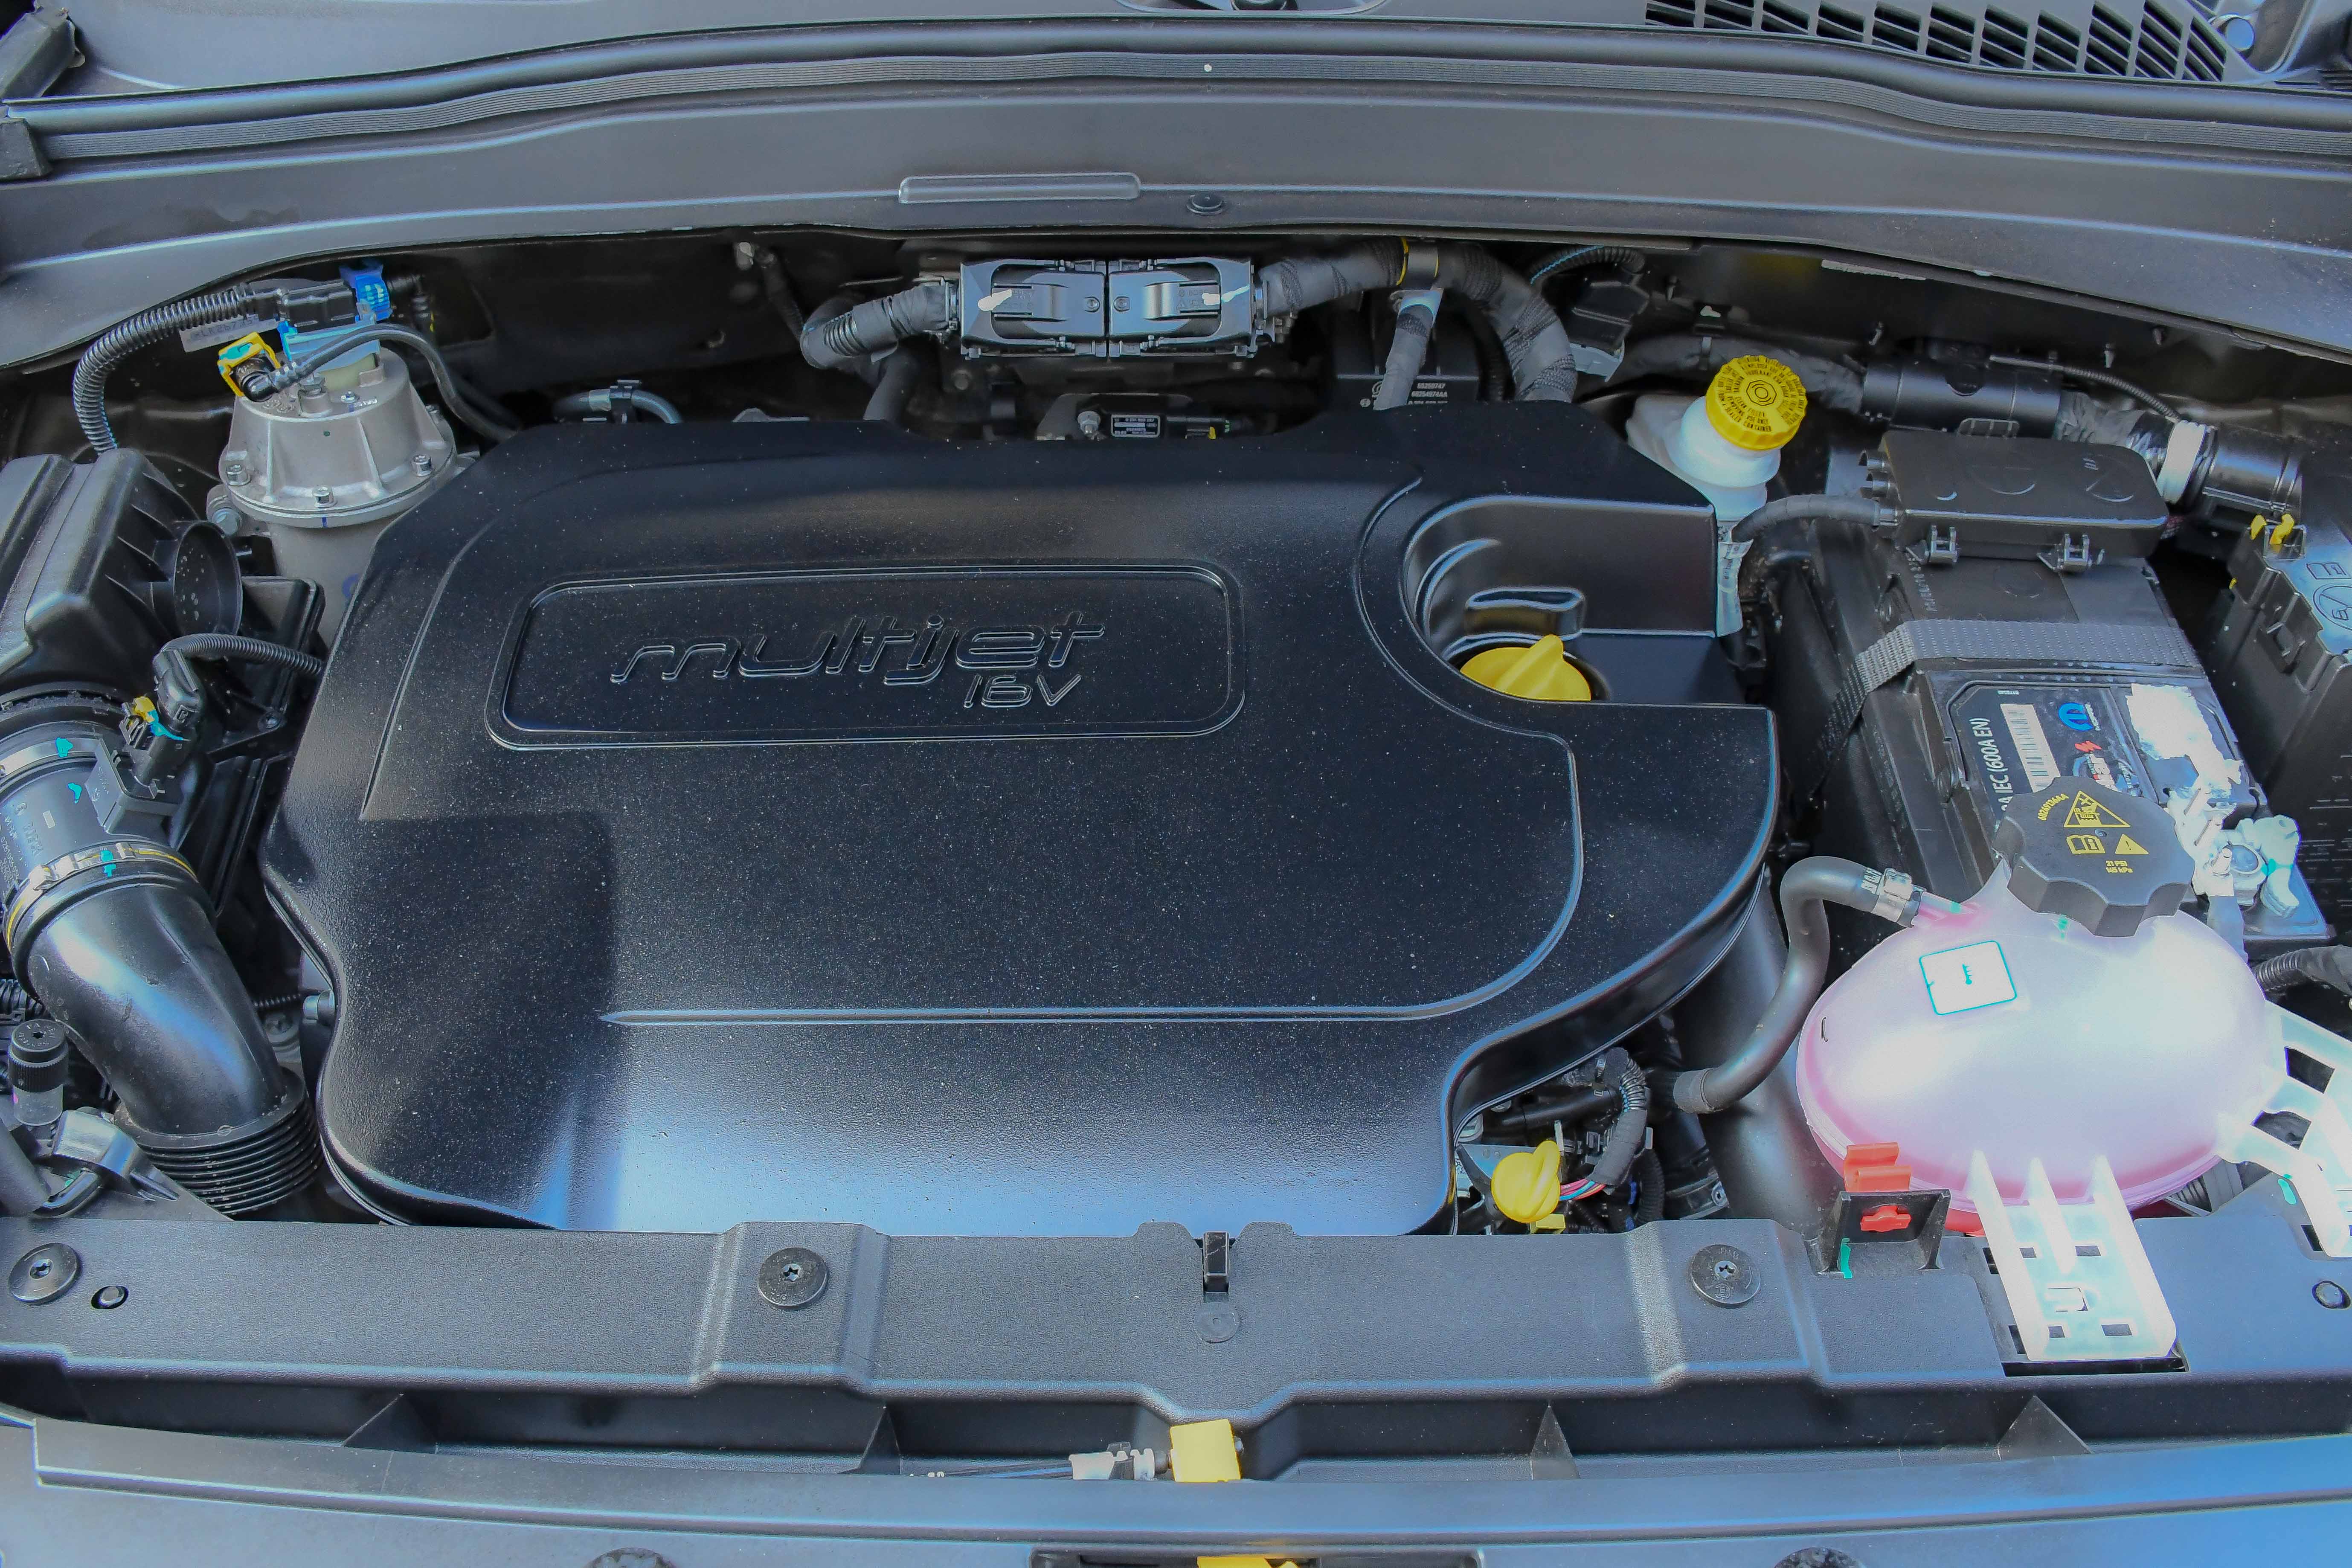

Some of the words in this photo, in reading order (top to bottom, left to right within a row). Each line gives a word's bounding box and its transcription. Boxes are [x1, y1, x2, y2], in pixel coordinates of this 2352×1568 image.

[609, 611, 1106, 687] multijet
[963, 673, 1083, 709] 16V
[1969, 717, 1993, 737] EN)
[1977, 739, 2008, 772] (600A
[1989, 774, 2014, 793] IEC
